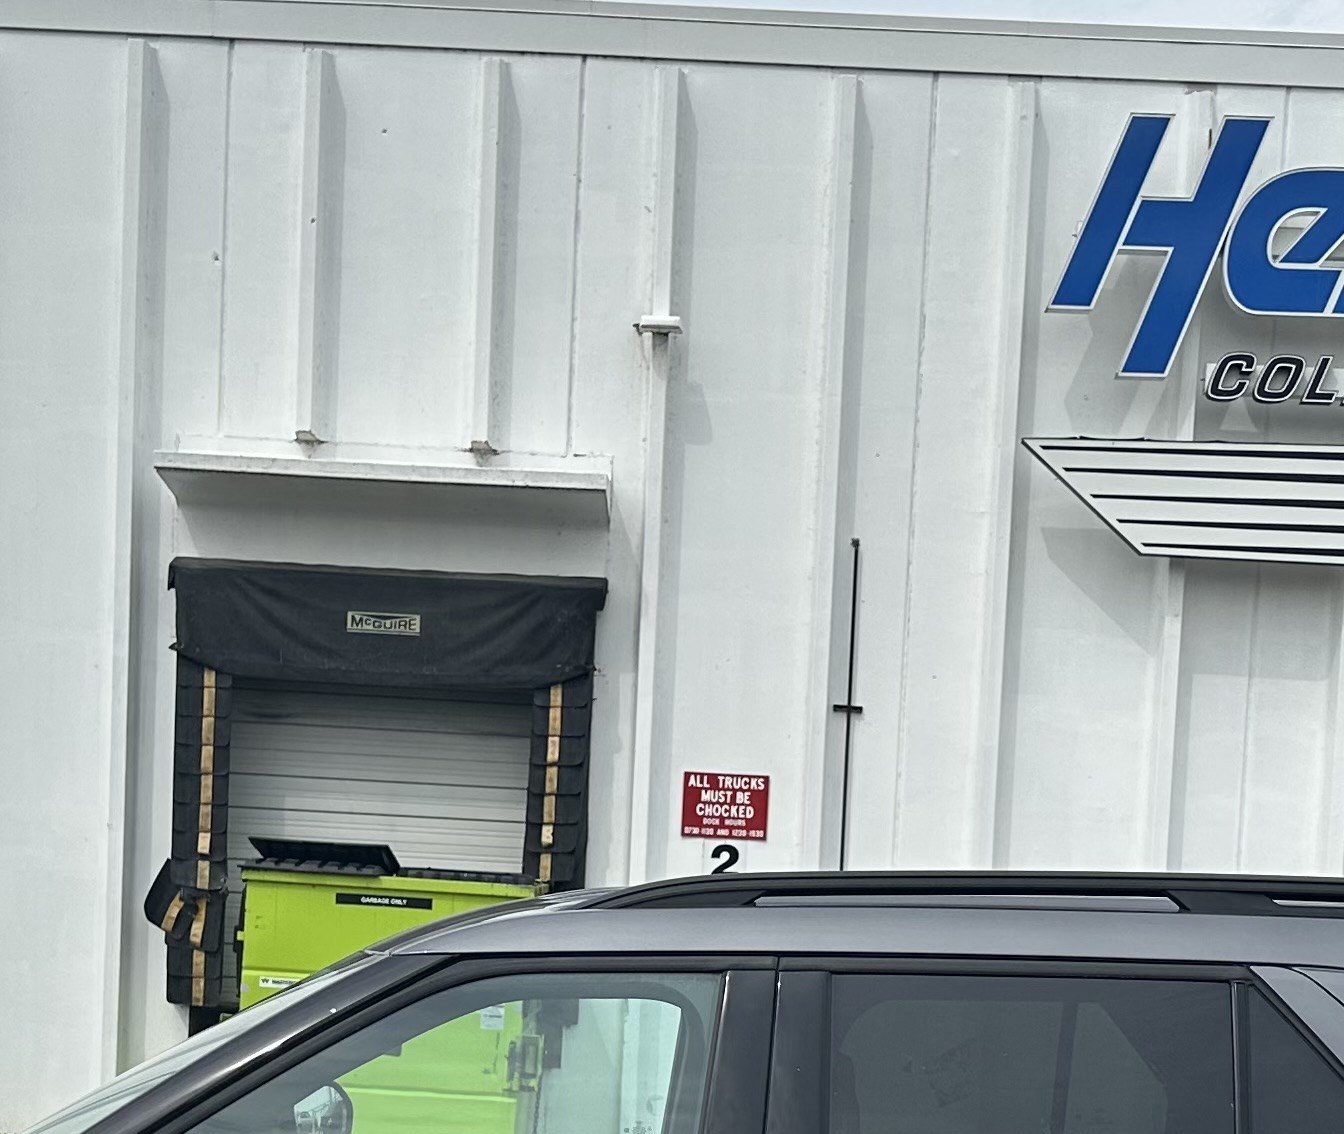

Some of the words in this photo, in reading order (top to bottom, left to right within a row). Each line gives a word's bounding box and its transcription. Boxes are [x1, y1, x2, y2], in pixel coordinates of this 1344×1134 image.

[688, 775, 710, 788] ALL
[718, 776, 765, 790] TRUCKS
[701, 790, 732, 803] MUST
[736, 792, 752, 804] BE
[696, 803, 755, 818] CHOCKED
[711, 844, 740, 875] 2
